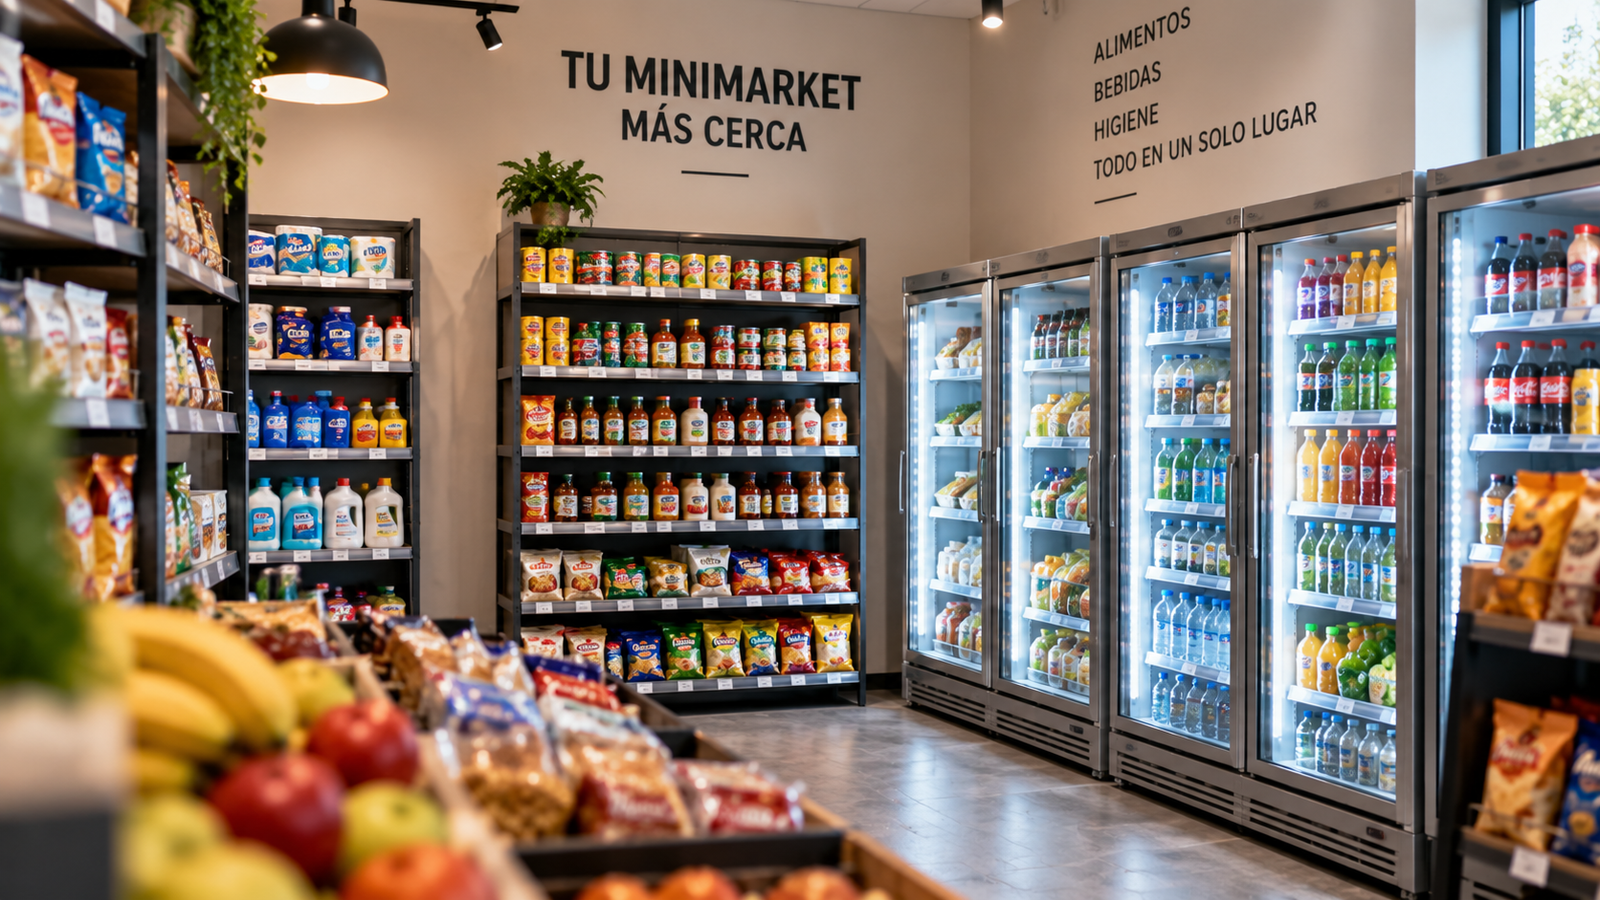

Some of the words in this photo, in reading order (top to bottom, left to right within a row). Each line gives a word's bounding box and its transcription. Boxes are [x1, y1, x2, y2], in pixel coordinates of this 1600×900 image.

[1093, 6, 1191, 64] ALIMENTOS
[560, 49, 610, 92] TU
[625, 55, 862, 111] MINIMARKET
[1094, 60, 1162, 103] BEBIDAS
[621, 103, 693, 145] MÁS
[704, 115, 807, 152] CERCA
[1093, 151, 1137, 180] TODO
[1142, 143, 1163, 168] EN
[1169, 135, 1192, 160] UN
[1198, 121, 1246, 154] SOLO
[1252, 101, 1317, 139] LUGAR
[1094, 102, 1159, 142] HIGIENE
